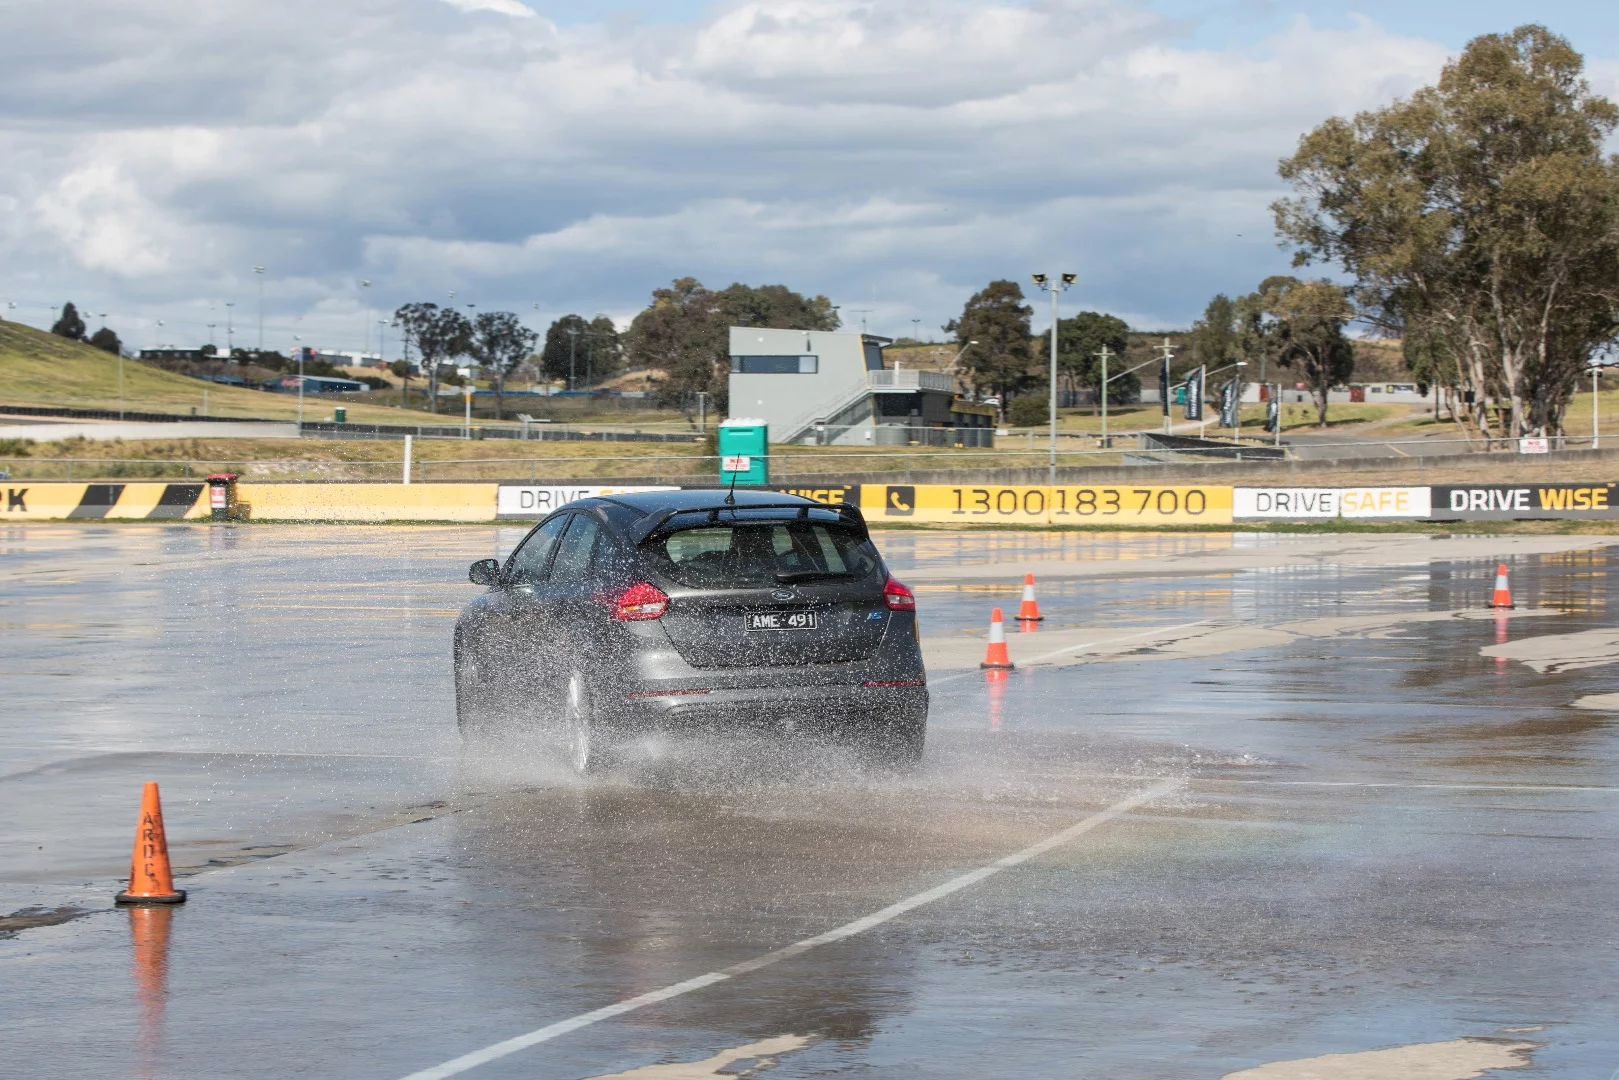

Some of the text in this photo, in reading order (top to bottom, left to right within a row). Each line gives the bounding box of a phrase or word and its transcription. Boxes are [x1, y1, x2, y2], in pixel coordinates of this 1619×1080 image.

[0, 488, 29, 512] K
[952, 489, 1206, 515] 1300 183 700
[1256, 492, 1409, 512] DRIVE SAFE
[1450, 488, 1609, 511] DRIVE WISE
